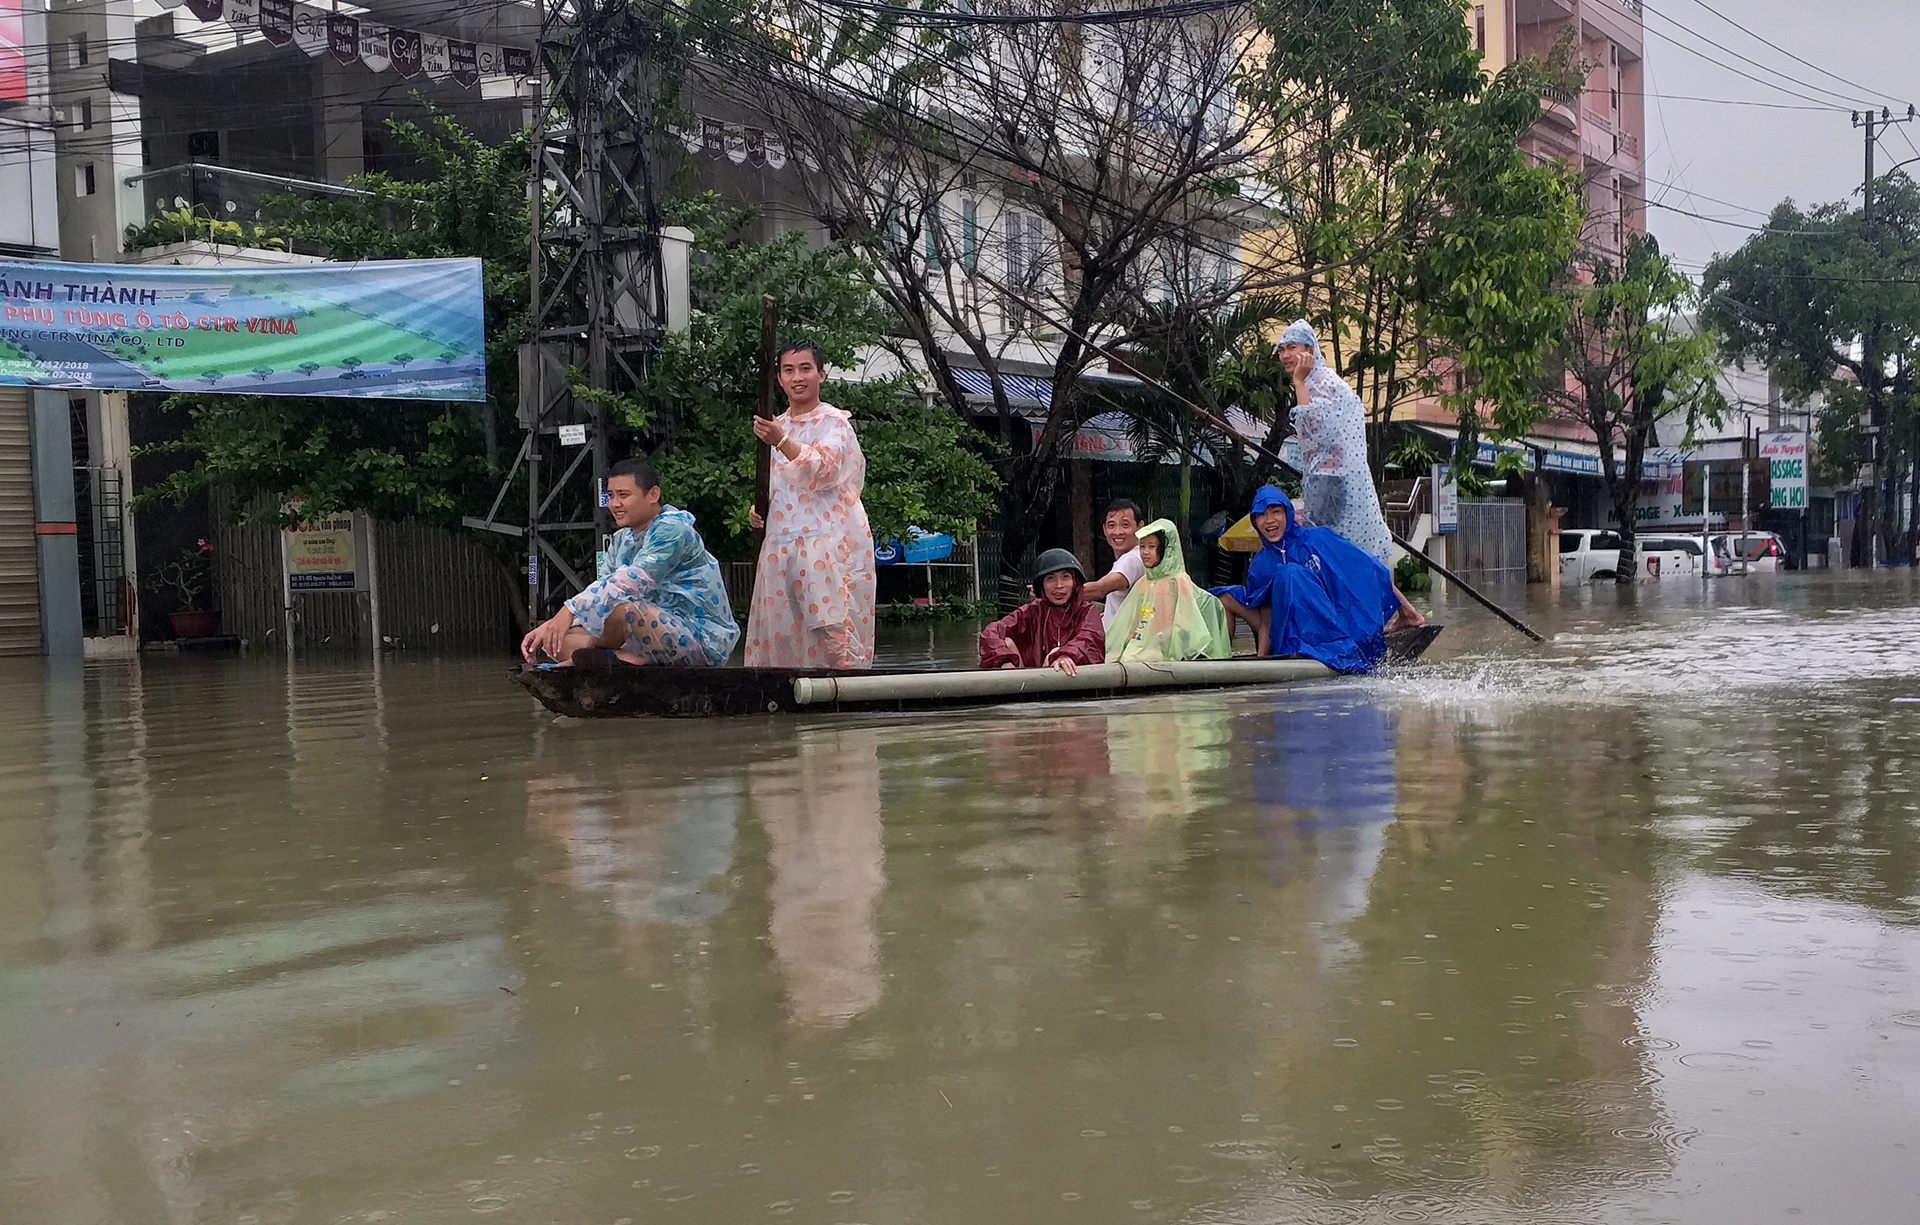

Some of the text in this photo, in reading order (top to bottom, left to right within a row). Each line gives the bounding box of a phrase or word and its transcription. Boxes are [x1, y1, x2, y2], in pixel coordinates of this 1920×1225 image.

[391, 36, 419, 65] Café
[63, 280, 157, 306] THÀNH
[4, 305, 298, 335] PHỤ TÙNG Ô TÔ CTR VINA
[38, 330, 69, 342] CTR
[75, 332, 115, 345] VINA
[121, 335, 151, 348] CO.,
[157, 337, 185, 348] LTD
[0, 368, 50, 378] December
[67, 371, 92, 380] 2018
[35, 360, 89, 370] 7/12/2018
[1771, 459, 1803, 480] ASSAGE
